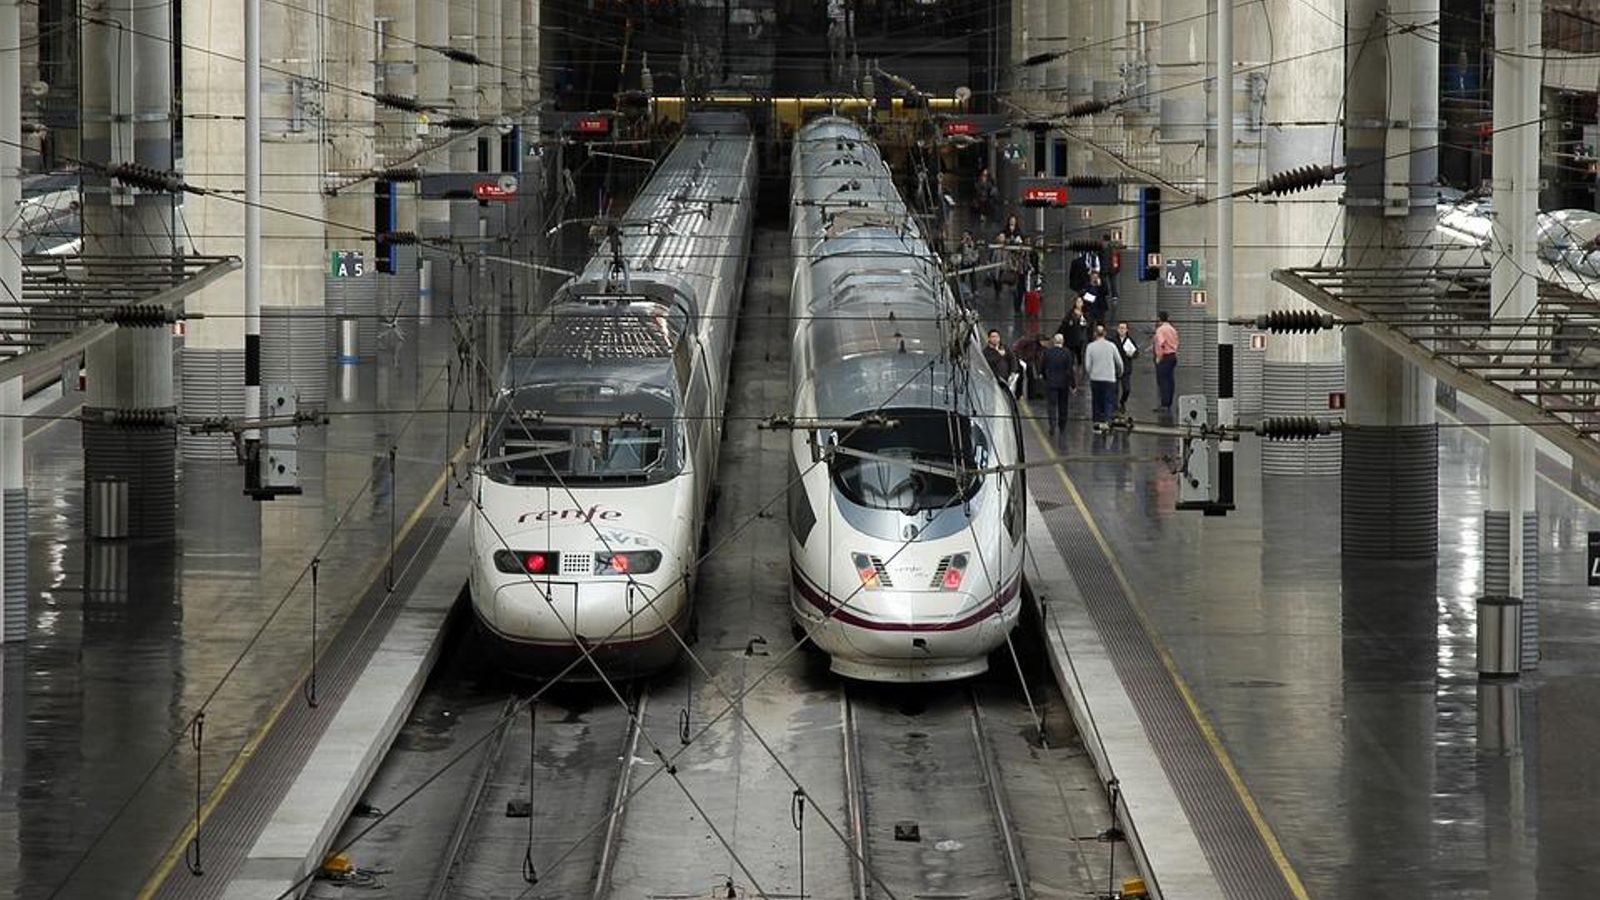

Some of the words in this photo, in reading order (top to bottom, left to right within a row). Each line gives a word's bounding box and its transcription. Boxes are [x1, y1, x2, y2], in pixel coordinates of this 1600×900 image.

[338, 263, 348, 277] A
[354, 263, 363, 277] 5
[1167, 271, 1177, 285] 4
[1182, 271, 1192, 285] A
[517, 503, 623, 524] renfe
[594, 530, 650, 547] AVE
